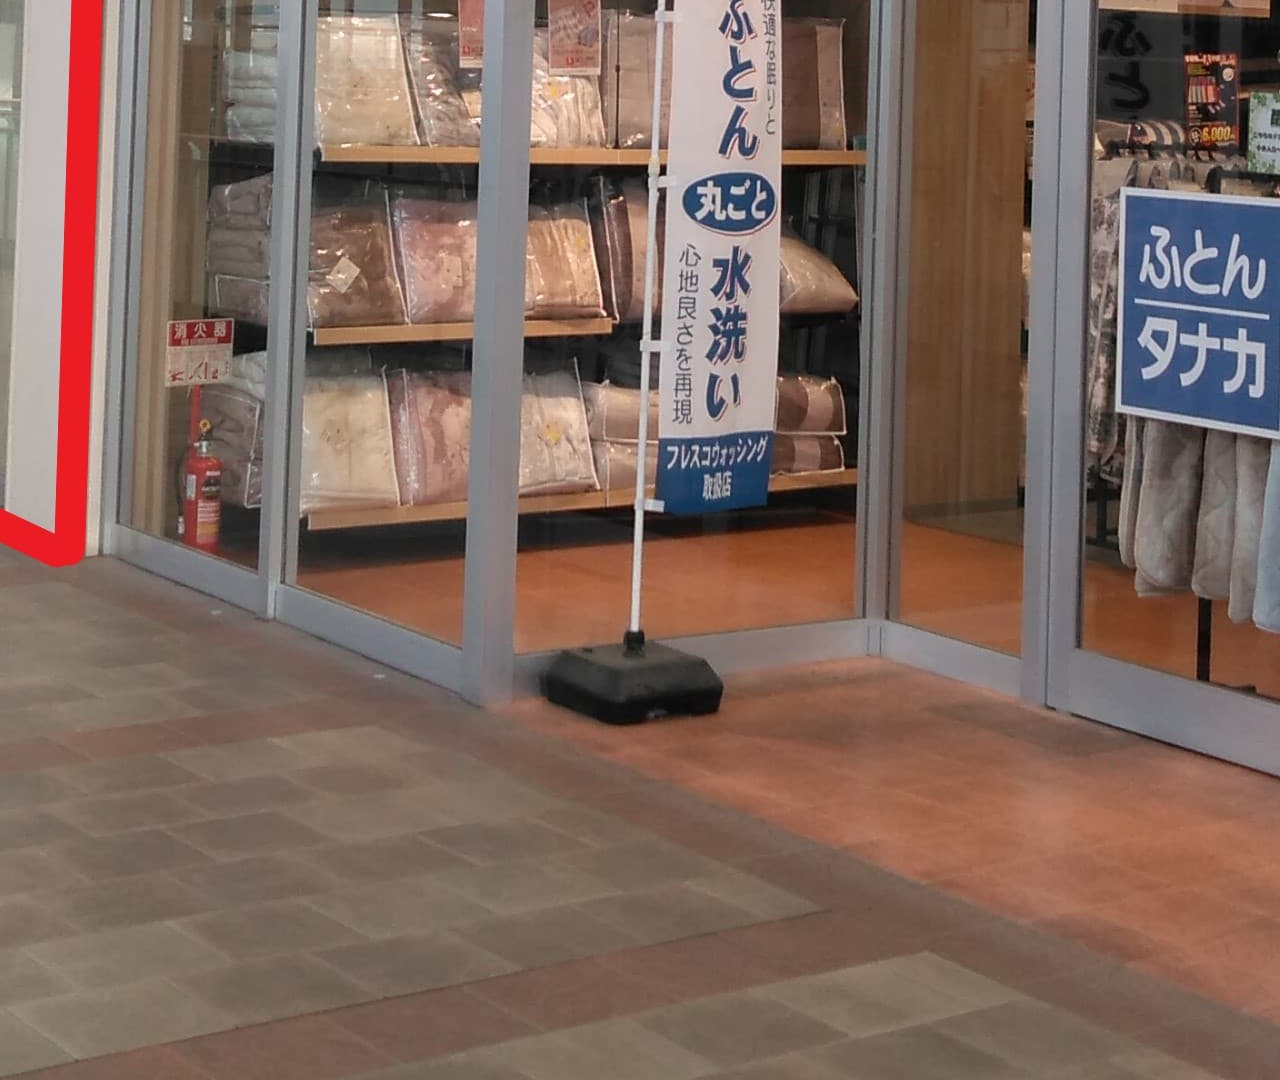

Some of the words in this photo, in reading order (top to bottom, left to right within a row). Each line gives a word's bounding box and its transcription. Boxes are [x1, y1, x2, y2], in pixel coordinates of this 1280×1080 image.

[694, 178, 768, 222] 丸ごと
[1138, 224, 1267, 301] ふとん
[174, 321, 226, 339] 消火器
[671, 242, 702, 426] 心地良さを再現
[704, 244, 752, 422] 水洗い
[1136, 315, 1267, 399] タナカ
[666, 434, 768, 470] フレスコウォッシング
